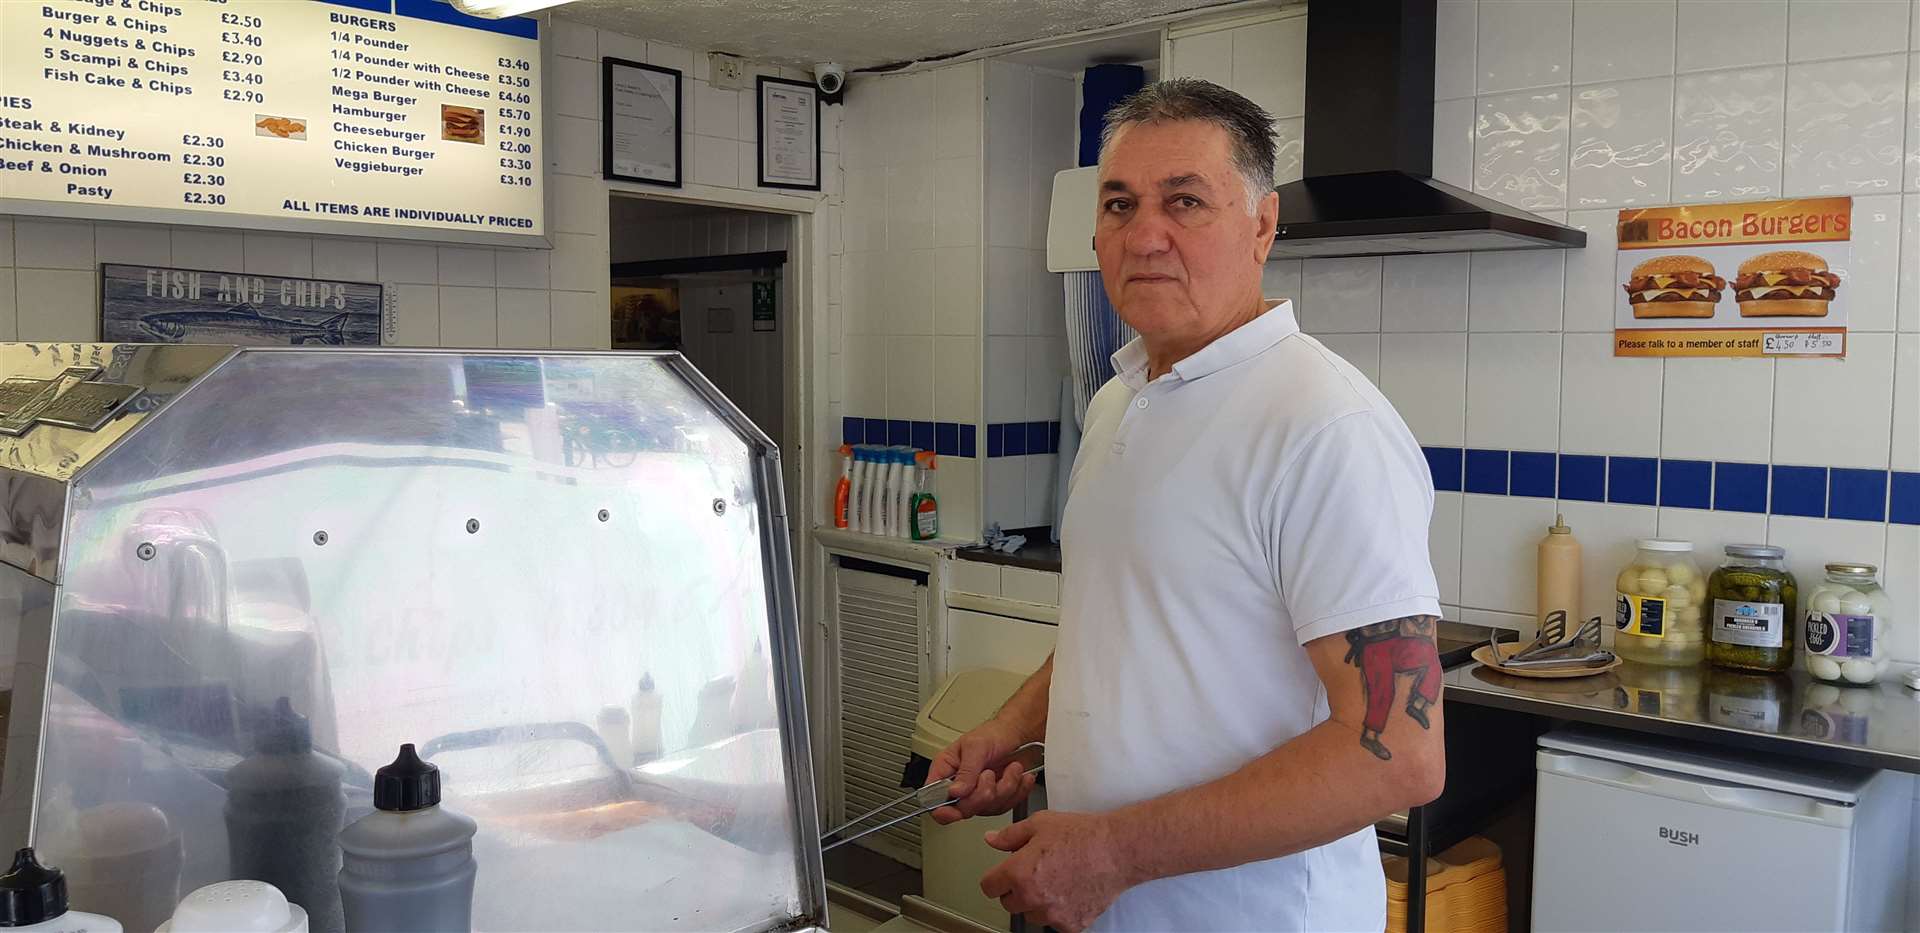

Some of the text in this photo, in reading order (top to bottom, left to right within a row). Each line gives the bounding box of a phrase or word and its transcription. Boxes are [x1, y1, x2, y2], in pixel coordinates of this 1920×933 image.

[42, 6, 262, 46] Burger & Chips £3.40
[138, 0, 182, 16] Chips
[221, 12, 262, 28] £2.50
[330, 12, 396, 32] BURGERS
[44, 27, 262, 66] 4 Nuggets & Chips £2.90
[331, 31, 530, 70] 1/4 Pounder £3.40
[44, 48, 263, 84] 5 Scampi & Chips £3.40
[332, 50, 530, 88] 1/4 Pounder with Cheese £3.50
[44, 68, 264, 104] Fish Cake & Chips £2.90
[332, 68, 530, 104] 1/2 Pounder with Cheese £4.60
[0, 96, 32, 110] IES
[332, 86, 530, 120] Mega Burger £5.70
[50, 121, 62, 132] &
[68, 123, 124, 140] Kidney
[183, 134, 224, 148] £2.30
[332, 104, 530, 137] Hamburger £1.90
[333, 122, 531, 154] Cheeseburger £2.00
[70, 144, 80, 154] &
[88, 145, 170, 162] Mushroom
[183, 154, 224, 167] £2.30
[334, 140, 531, 170] Chicken Burger £3.30
[41, 162, 52, 172] &
[60, 163, 106, 176] Onion
[184, 172, 225, 186] £2.30
[335, 158, 532, 186] Veggieburger £3.10
[68, 184, 226, 205] Pasty £2.30
[282, 200, 533, 228] ALL ITEMS ARE INDIVIDUALLY PRICED
[1658, 212, 1848, 240] Bacon Burgers
[146, 269, 200, 300] FISH
[218, 276, 265, 304] AND
[280, 279, 346, 310] CHIPS
[1618, 340, 1646, 348] Please
[1648, 340, 1664, 348] talk
[1667, 340, 1676, 348] to
[1686, 340, 1723, 348] member
[1726, 340, 1735, 348] of
[1738, 339, 1760, 348] staff
[1659, 826, 1699, 845] BUSH
